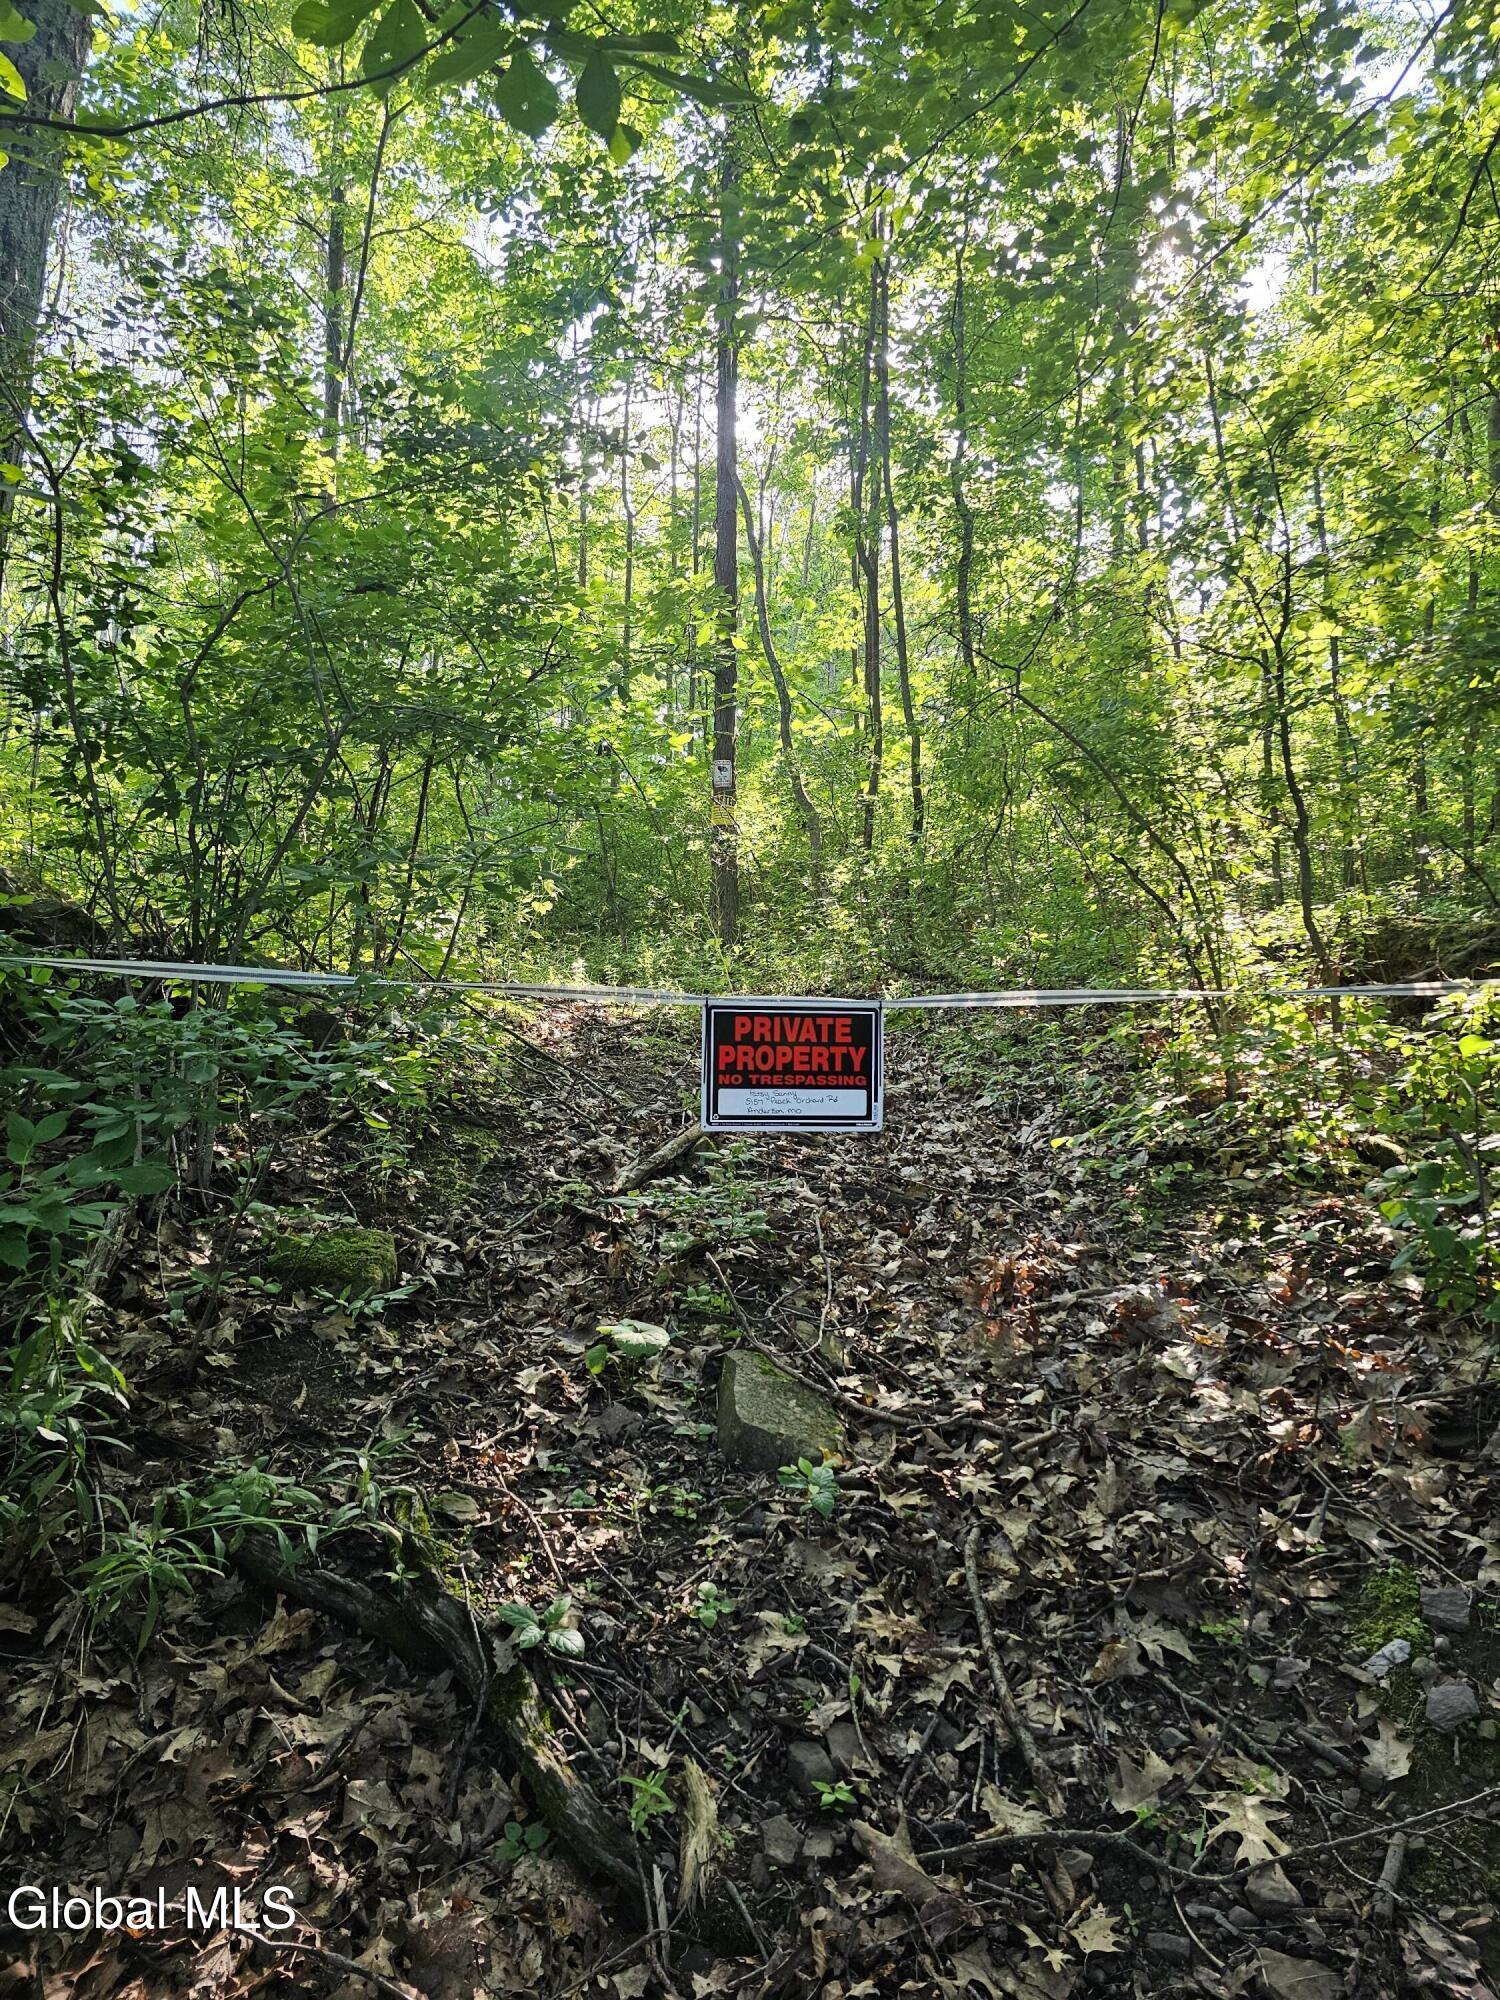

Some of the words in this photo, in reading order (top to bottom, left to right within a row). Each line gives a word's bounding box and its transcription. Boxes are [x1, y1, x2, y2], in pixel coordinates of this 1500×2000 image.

[734, 1016, 852, 1043] PRIVATE
[718, 1045, 866, 1072] PROPERTY
[718, 1074, 743, 1085] NO
[749, 1075, 867, 1086] TRESPASSING
[771, 1096, 791, 1104] Peach
